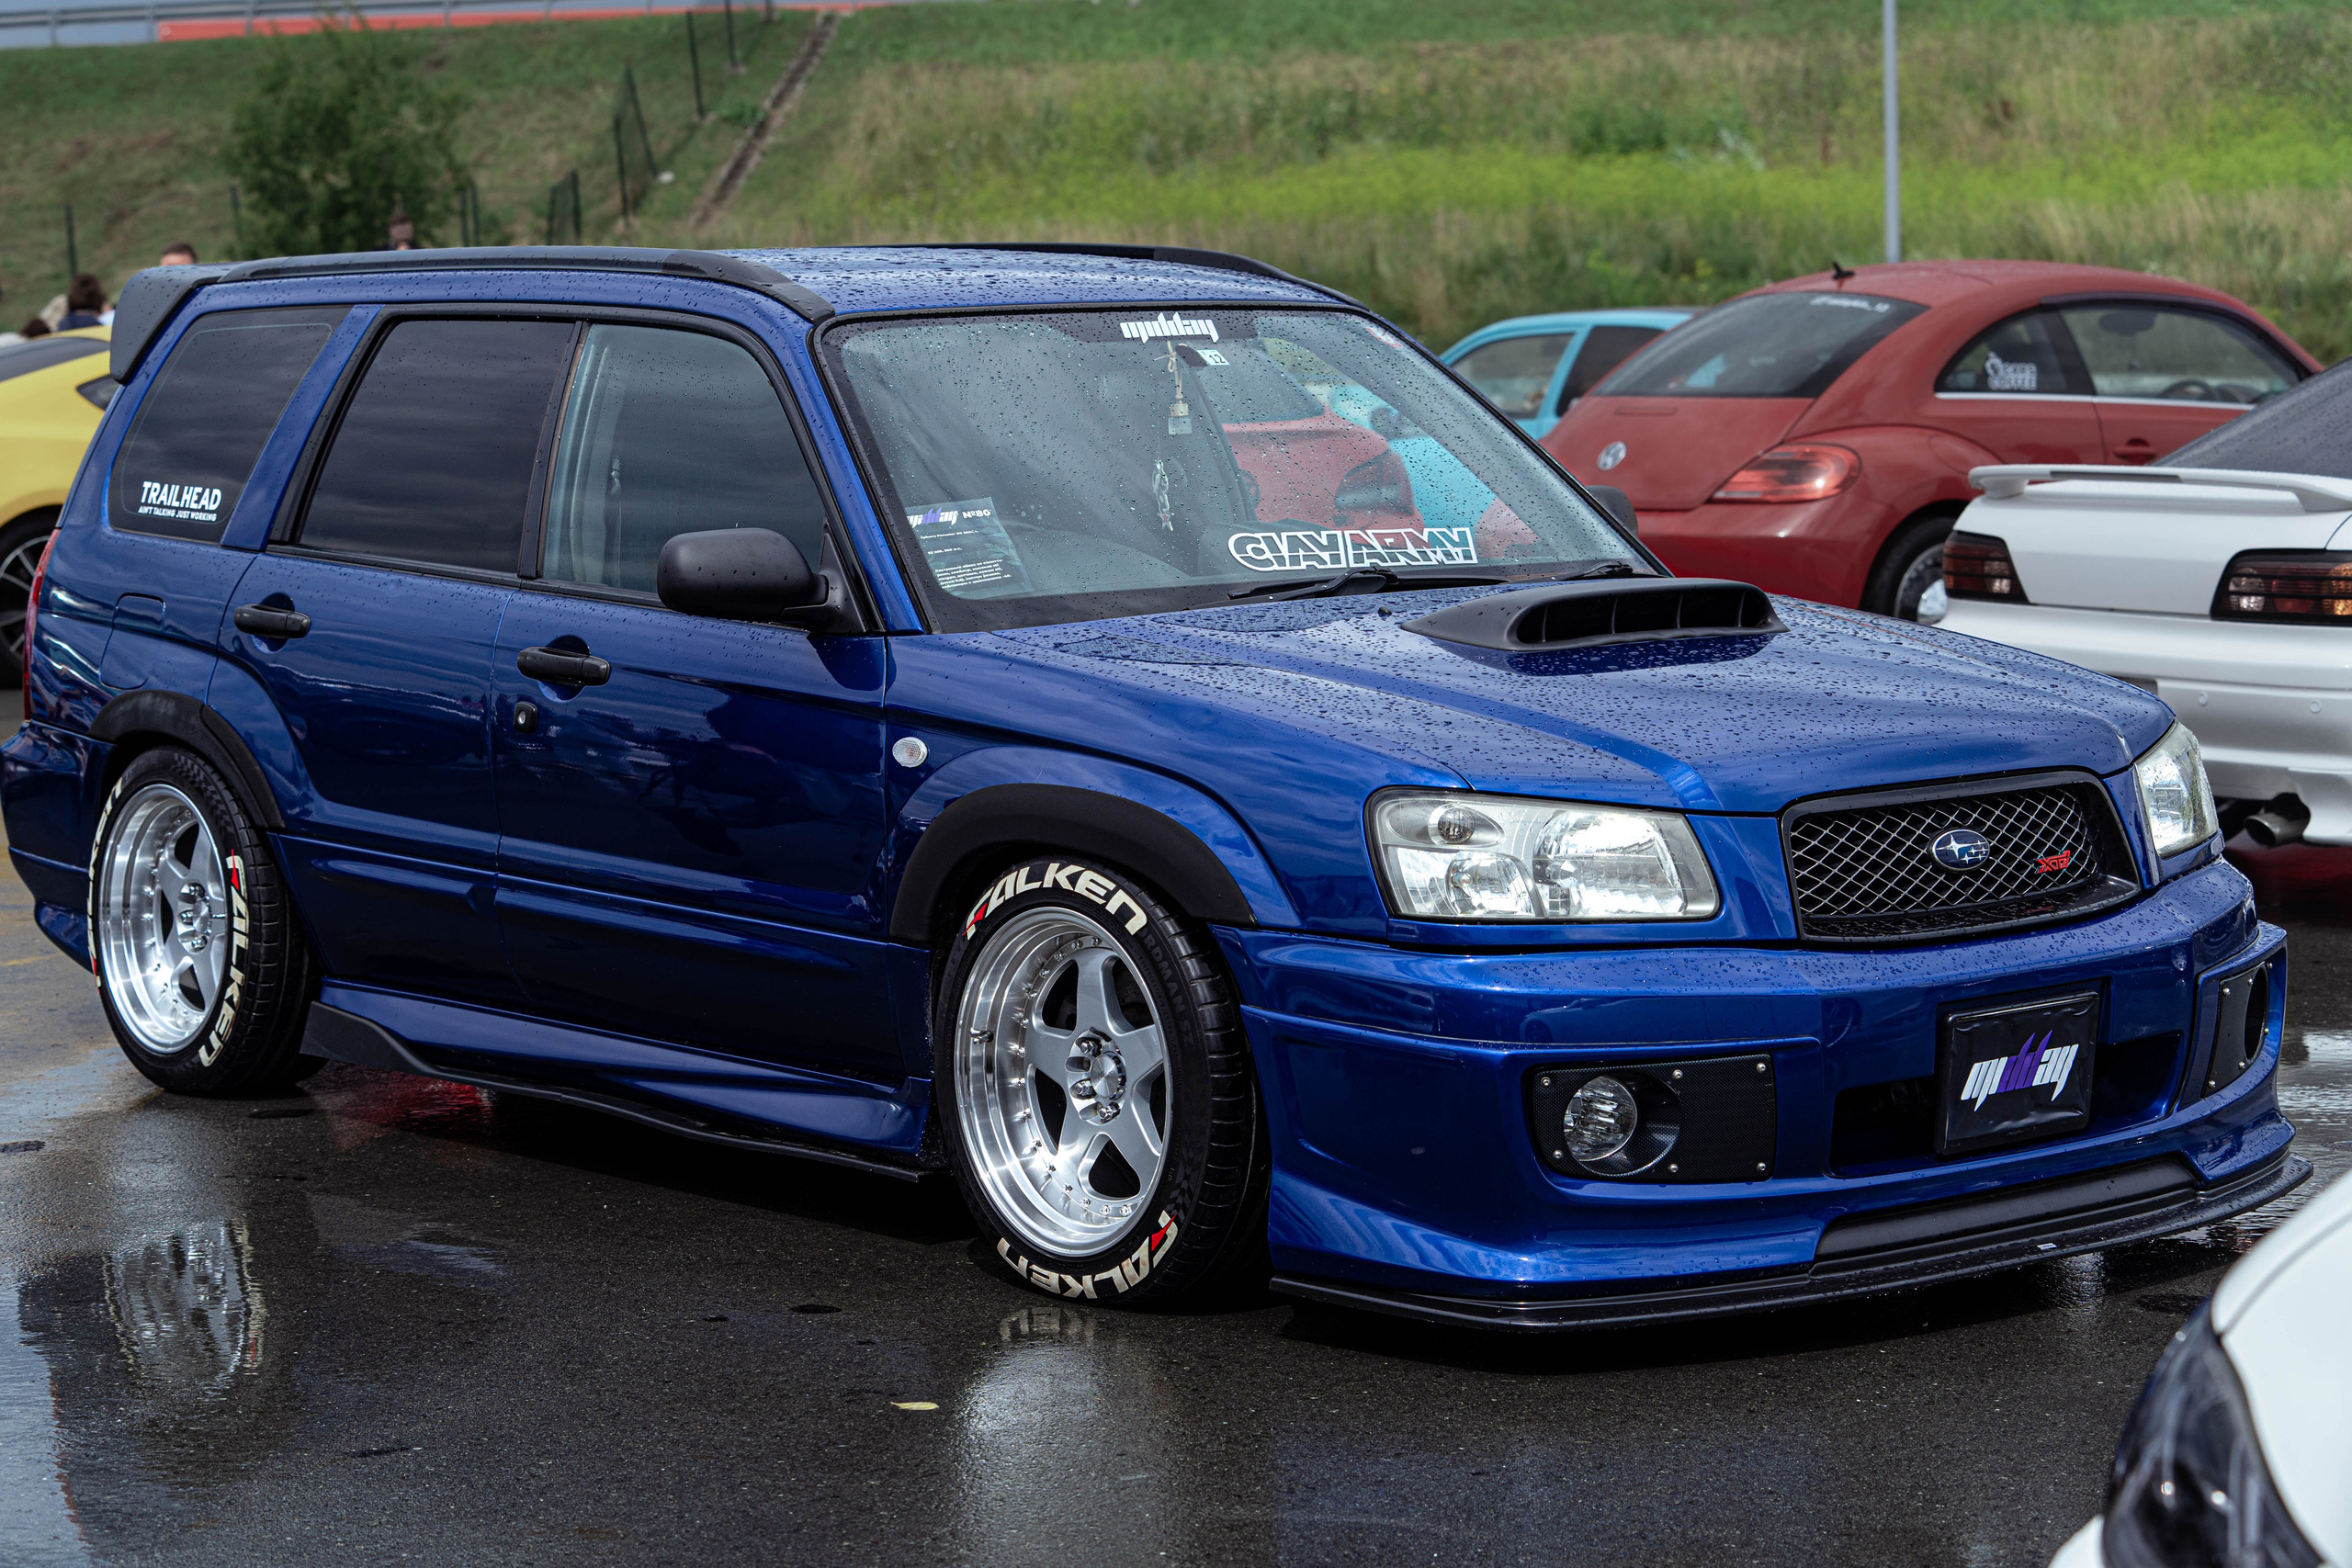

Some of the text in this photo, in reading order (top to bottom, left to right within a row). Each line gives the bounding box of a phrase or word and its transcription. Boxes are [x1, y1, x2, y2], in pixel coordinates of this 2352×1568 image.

[138, 505, 217, 522] AIN'T TALKING JUST WORKING
[141, 480, 222, 511] TRAILHEAD
[1344, 527, 1478, 568] ARMY
[962, 863, 1148, 941] FALKEN
[198, 849, 249, 1067] FALKEN
[1961, 1030, 2079, 1111] midday
[997, 1210, 1179, 1300] FALKEN
